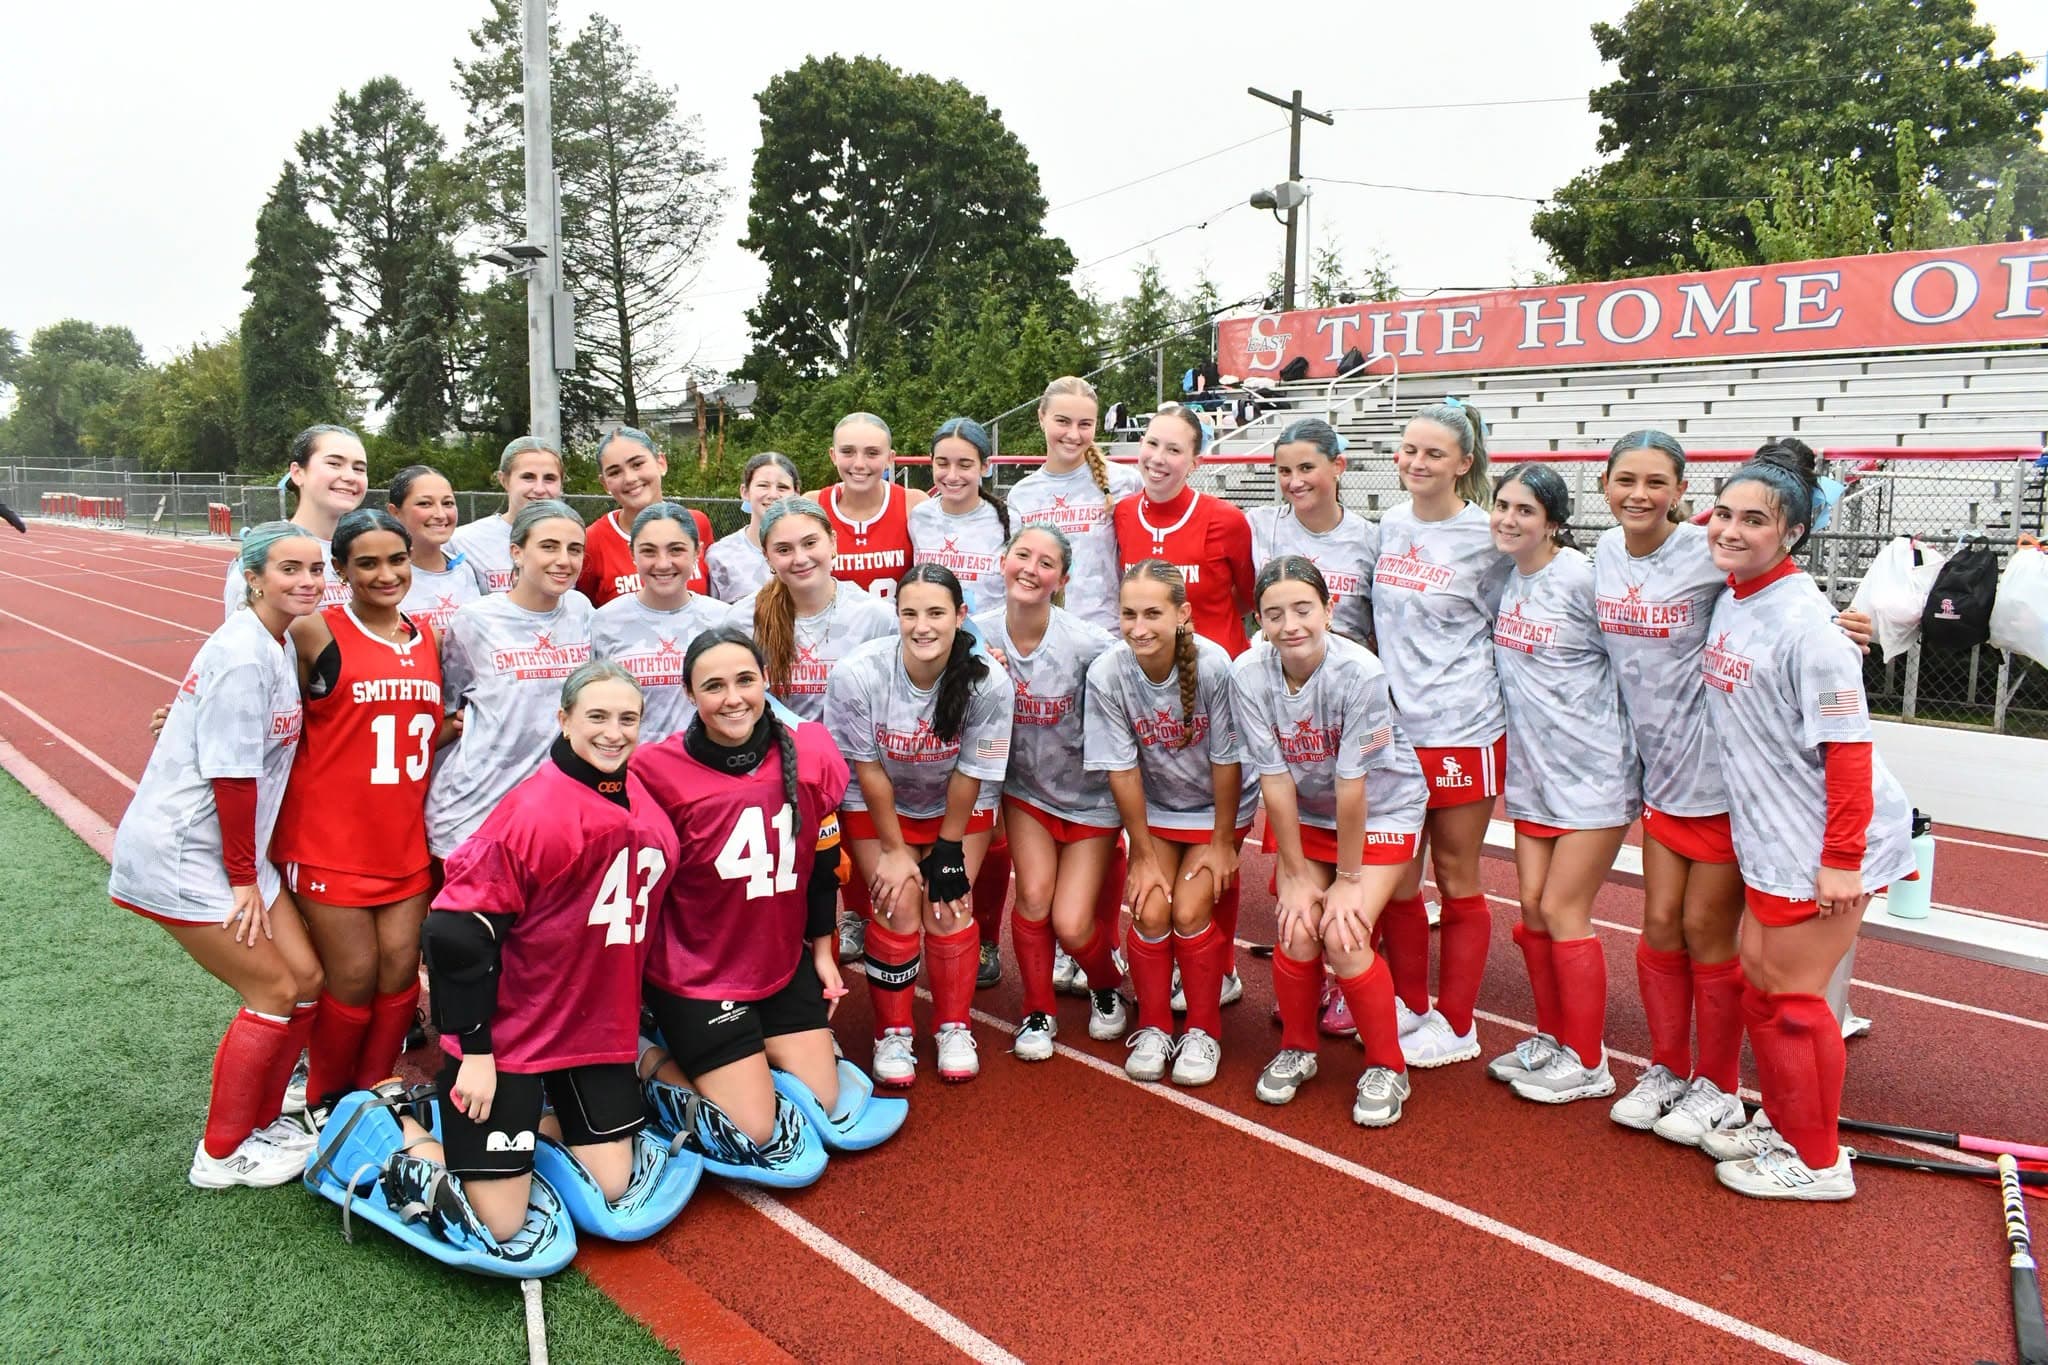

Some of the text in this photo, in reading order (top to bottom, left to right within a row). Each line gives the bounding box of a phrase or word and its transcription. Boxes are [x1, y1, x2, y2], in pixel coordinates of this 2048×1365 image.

[1316, 254, 2048, 361] THE HOME OF
[1247, 333, 1291, 352] EAST
[967, 555, 993, 571] EAST
[1419, 565, 1450, 586] EAST
[1328, 577, 1358, 594] EAST
[1651, 605, 1689, 624] EAST
[1523, 623, 1553, 644] EAST
[1604, 623, 1627, 633] FIELD
[496, 648, 569, 670] SMITHTOWN
[523, 670, 548, 679] FIELD
[1722, 657, 1750, 681] EAST
[639, 676, 665, 685] FIELD
[370, 713, 436, 785] 13
[875, 728, 942, 752] SMITHTOWN
[726, 751, 758, 768] OBO
[598, 780, 623, 793] OBO
[1436, 775, 1473, 788] BULLS
[1367, 833, 1405, 845] BULLS
[714, 803, 798, 900] 41
[588, 847, 667, 947] 43
